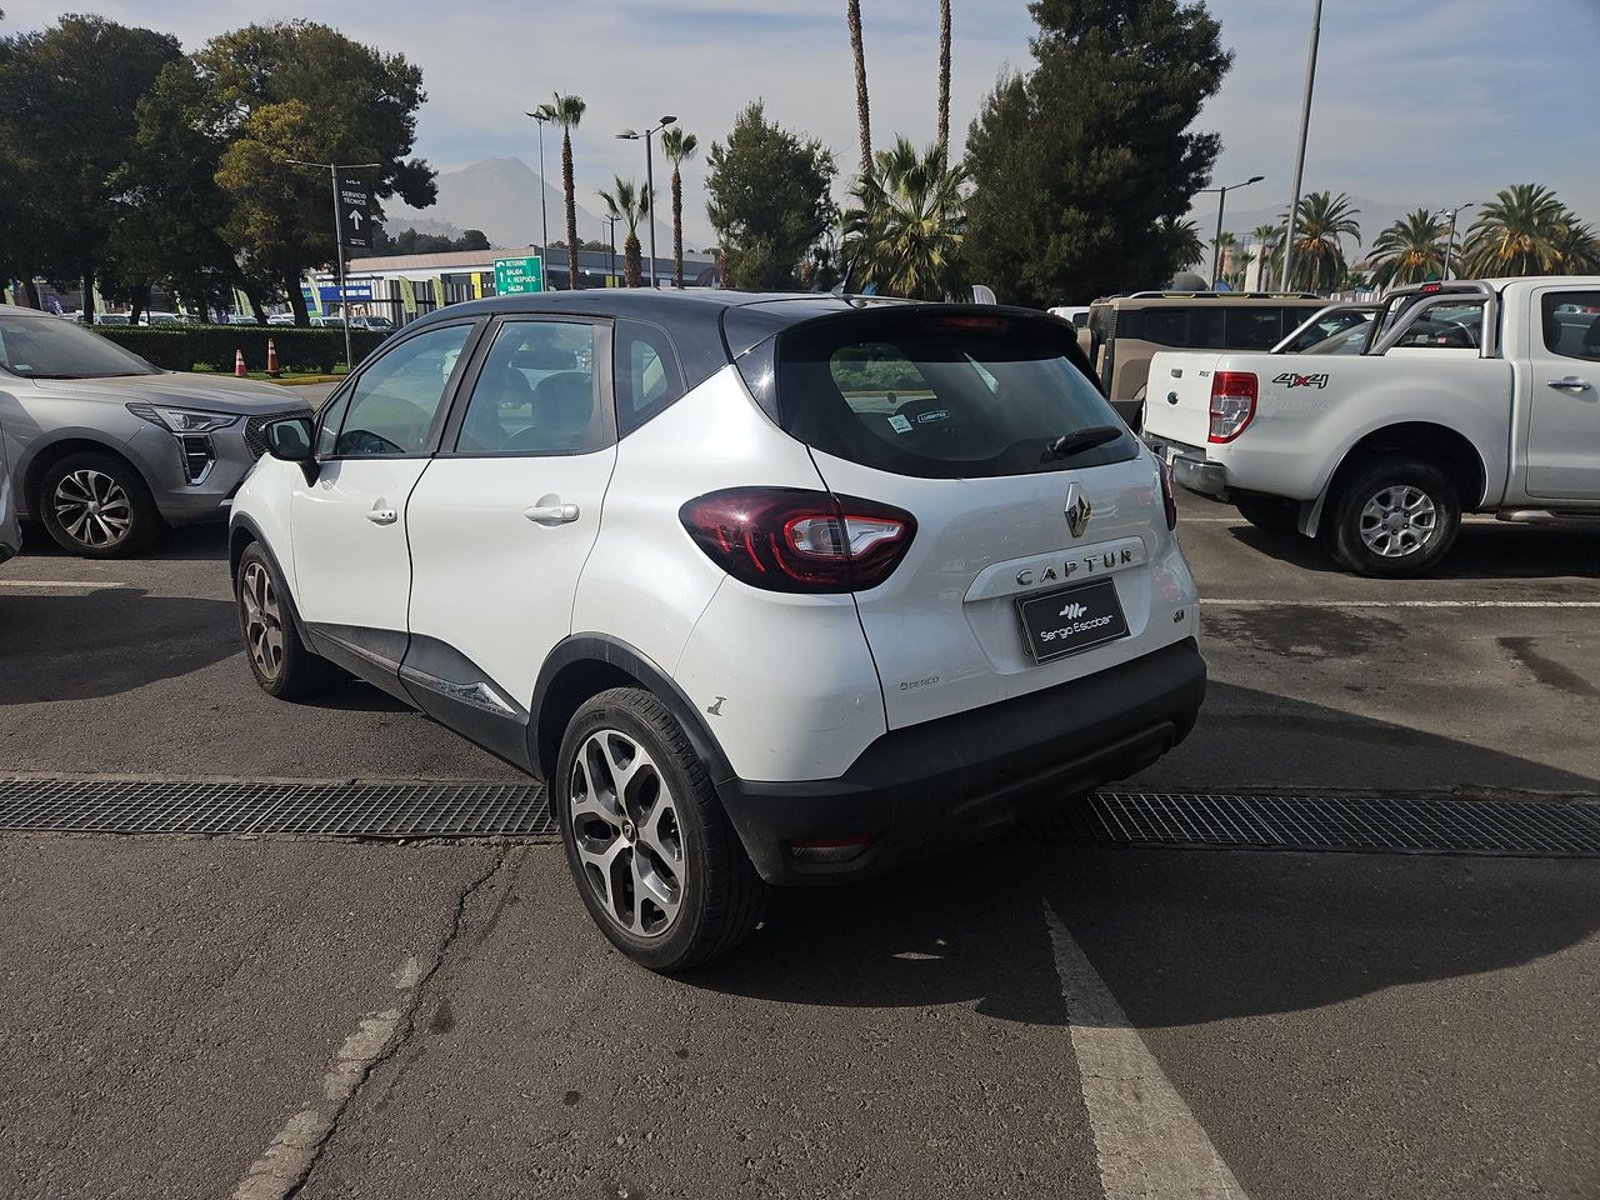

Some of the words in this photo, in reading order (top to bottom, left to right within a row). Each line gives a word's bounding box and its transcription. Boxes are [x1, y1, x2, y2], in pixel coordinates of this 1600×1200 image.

[341, 190, 367, 199] SERVICIO
[1016, 549, 1132, 585] CAPTUR
[1073, 614, 1114, 632] Escobar
[909, 676, 940, 690] DERCO
